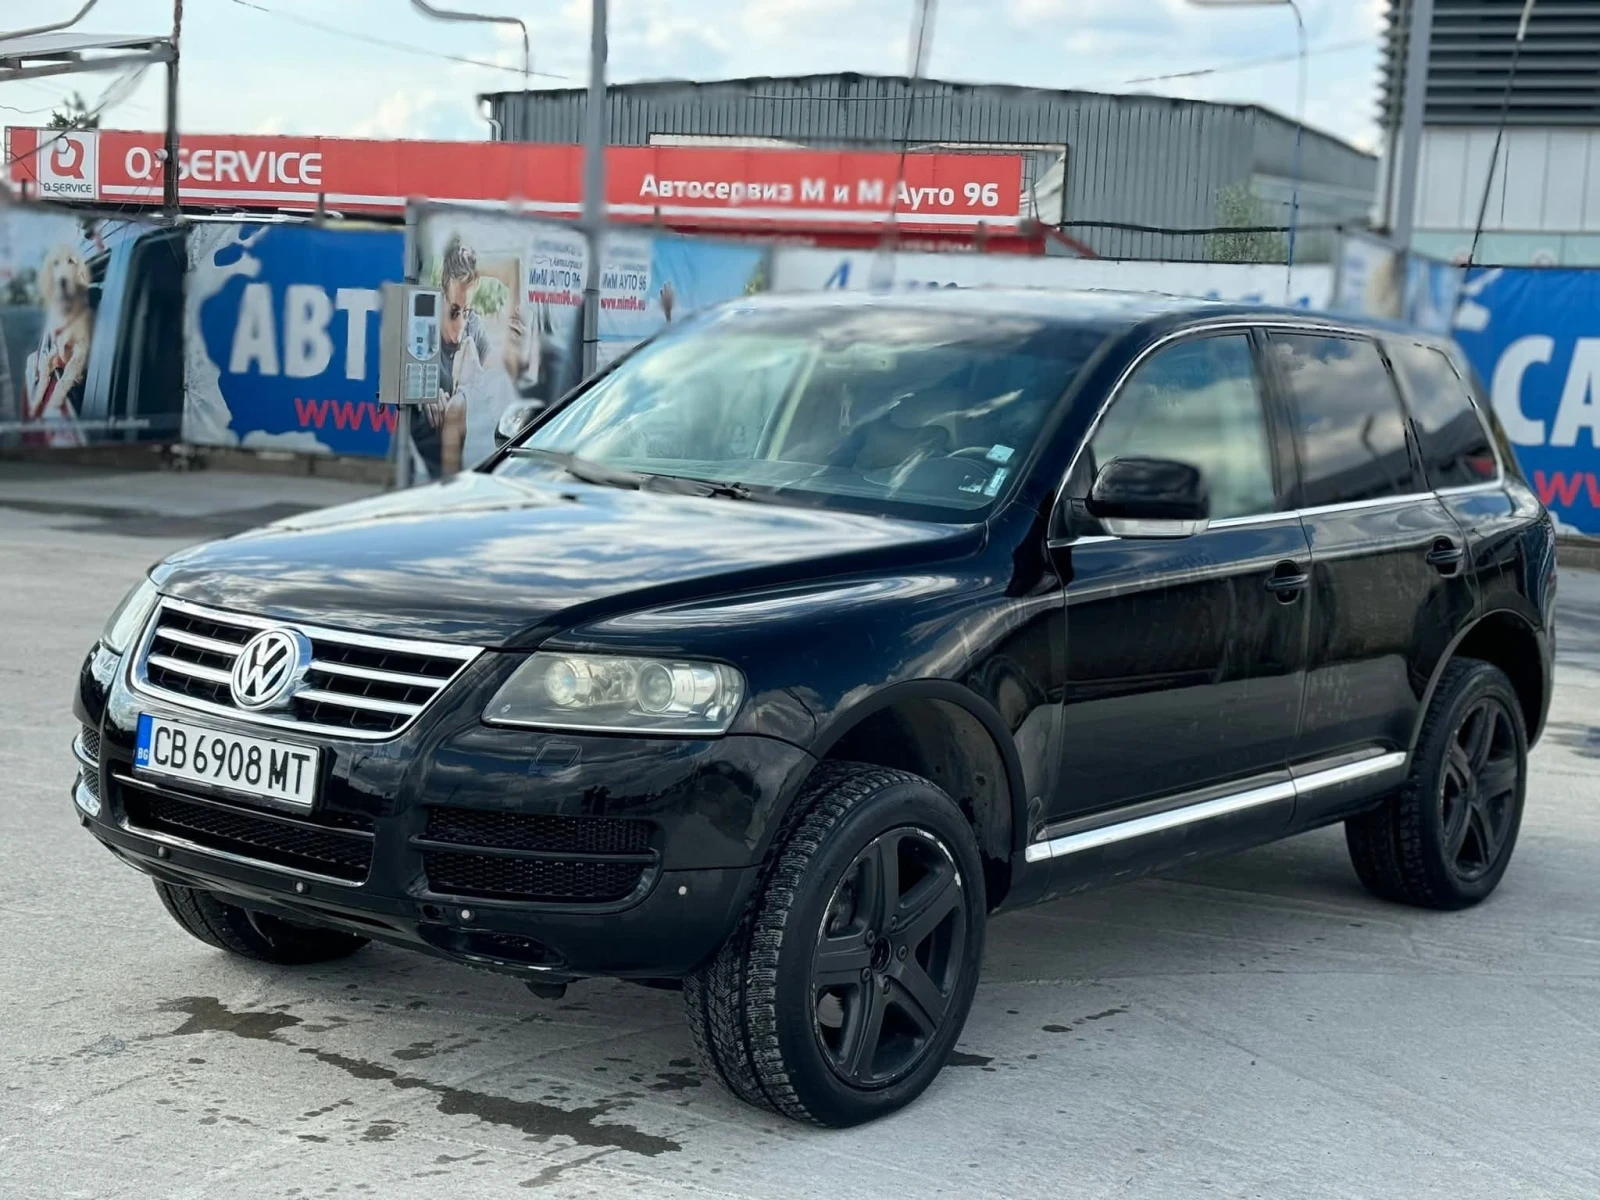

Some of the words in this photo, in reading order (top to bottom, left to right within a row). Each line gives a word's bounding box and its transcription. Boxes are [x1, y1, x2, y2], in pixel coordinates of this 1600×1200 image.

[639, 173, 793, 206] Автосервиз
[800, 178, 827, 203] М
[887, 180, 955, 211] Ауто
[964, 182, 1000, 208] 96
[137, 747, 149, 760] BG
